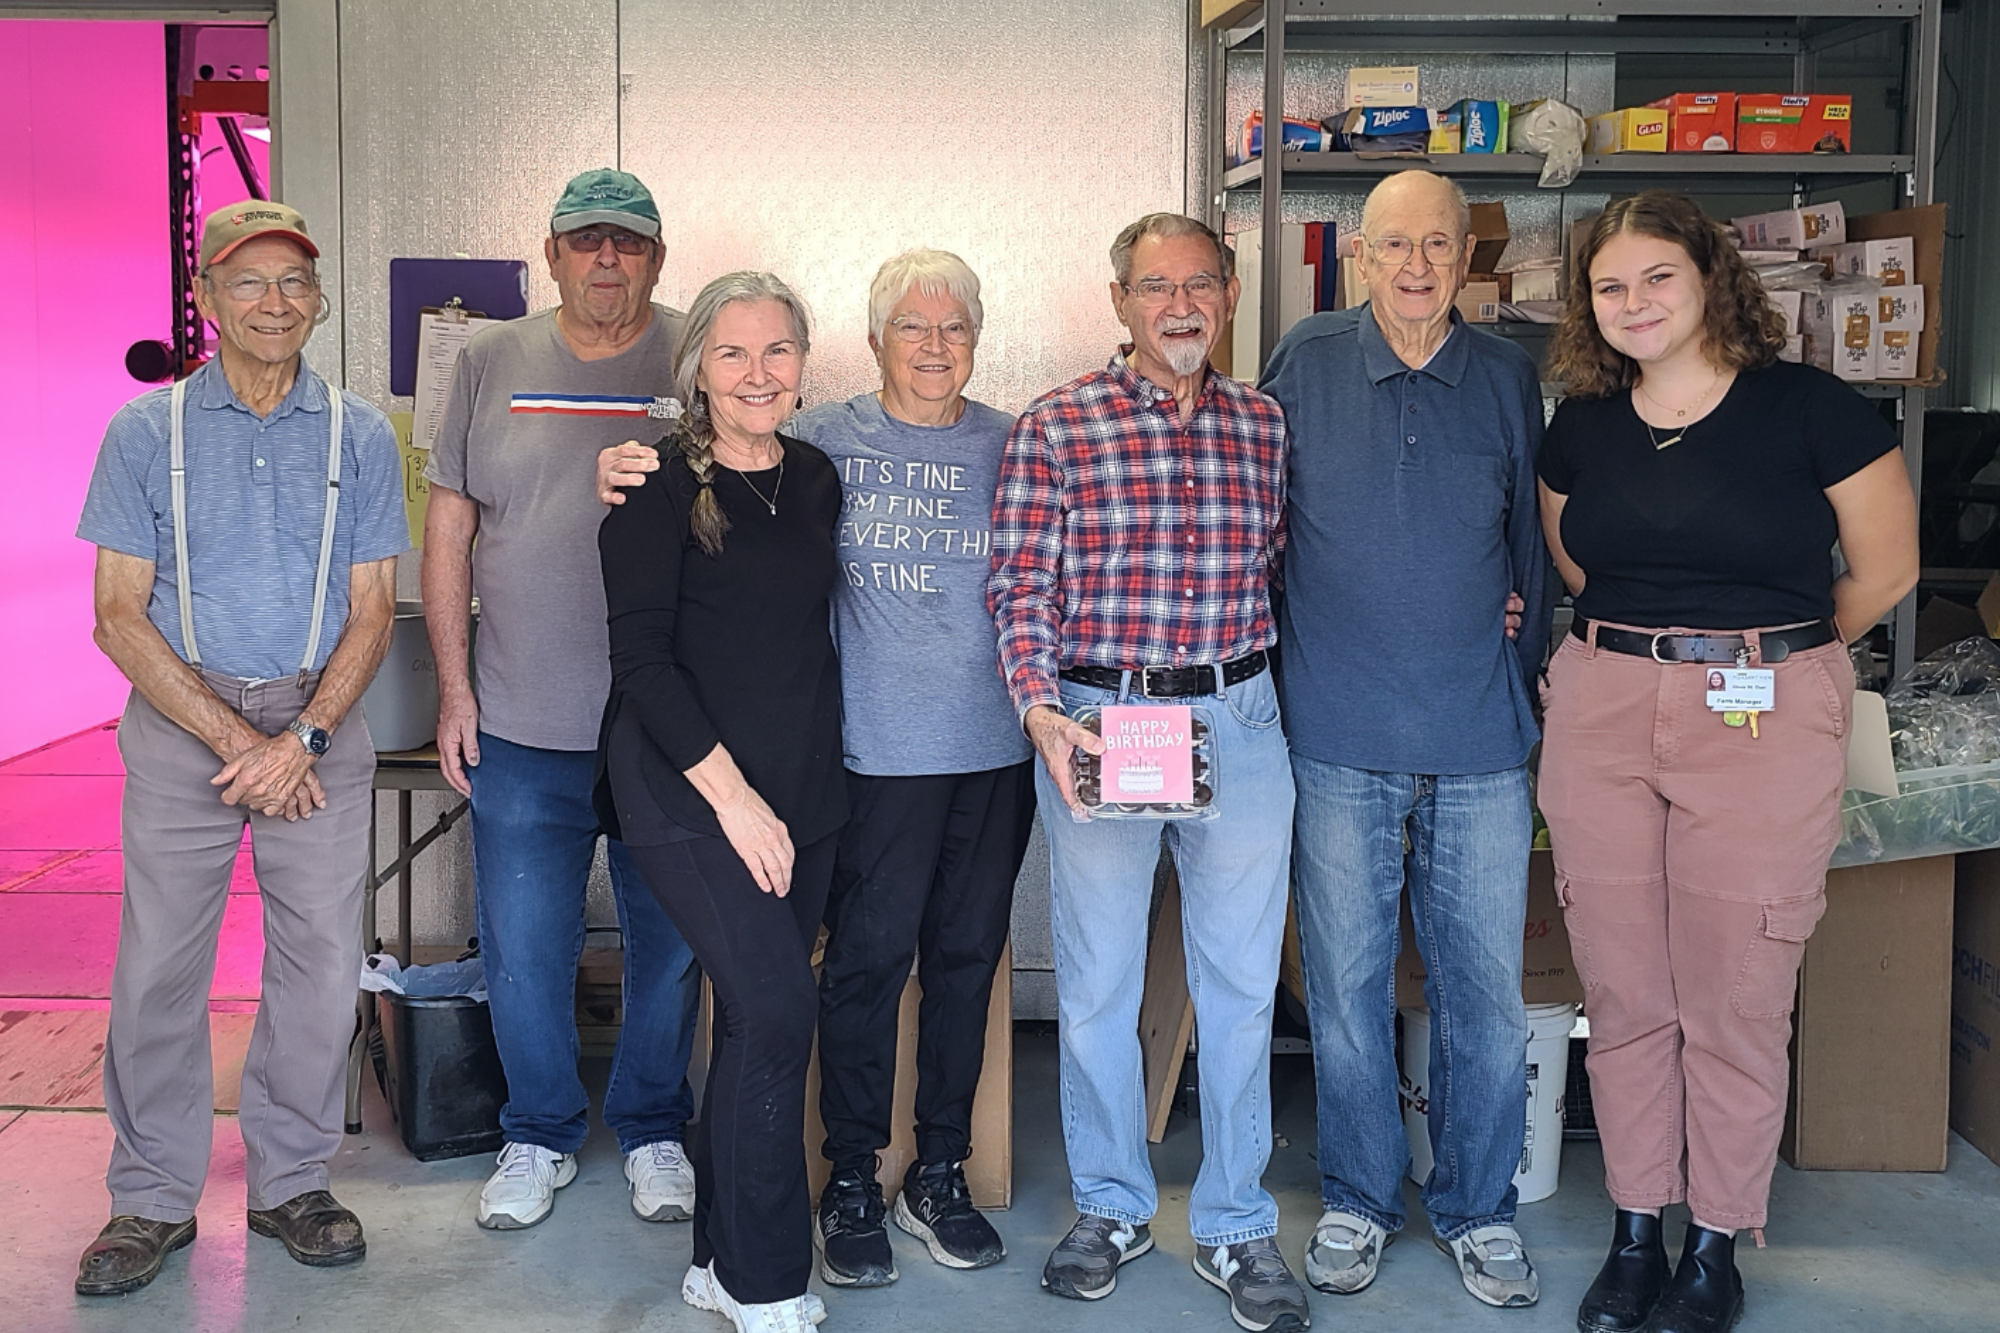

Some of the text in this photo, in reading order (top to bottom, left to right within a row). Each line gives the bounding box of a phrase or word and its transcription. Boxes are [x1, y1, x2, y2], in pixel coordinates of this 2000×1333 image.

[1372, 109, 1411, 128] Ziploc
[1469, 110, 1486, 147] Ziploc
[1638, 124, 1663, 136] GLAD
[640, 403, 670, 412] NORTH
[653, 396, 671, 404] THE
[648, 411, 671, 419] FACE
[844, 457, 972, 491] IT'S FINE.
[845, 491, 960, 520] I'M FINE.
[838, 522, 992, 556] EVERYTHI
[842, 561, 944, 593] IS FINE.
[1119, 720, 1170, 735] HAPPY
[1105, 732, 1184, 750] BIRTHDAY
[1523, 969, 1546, 978] Since
